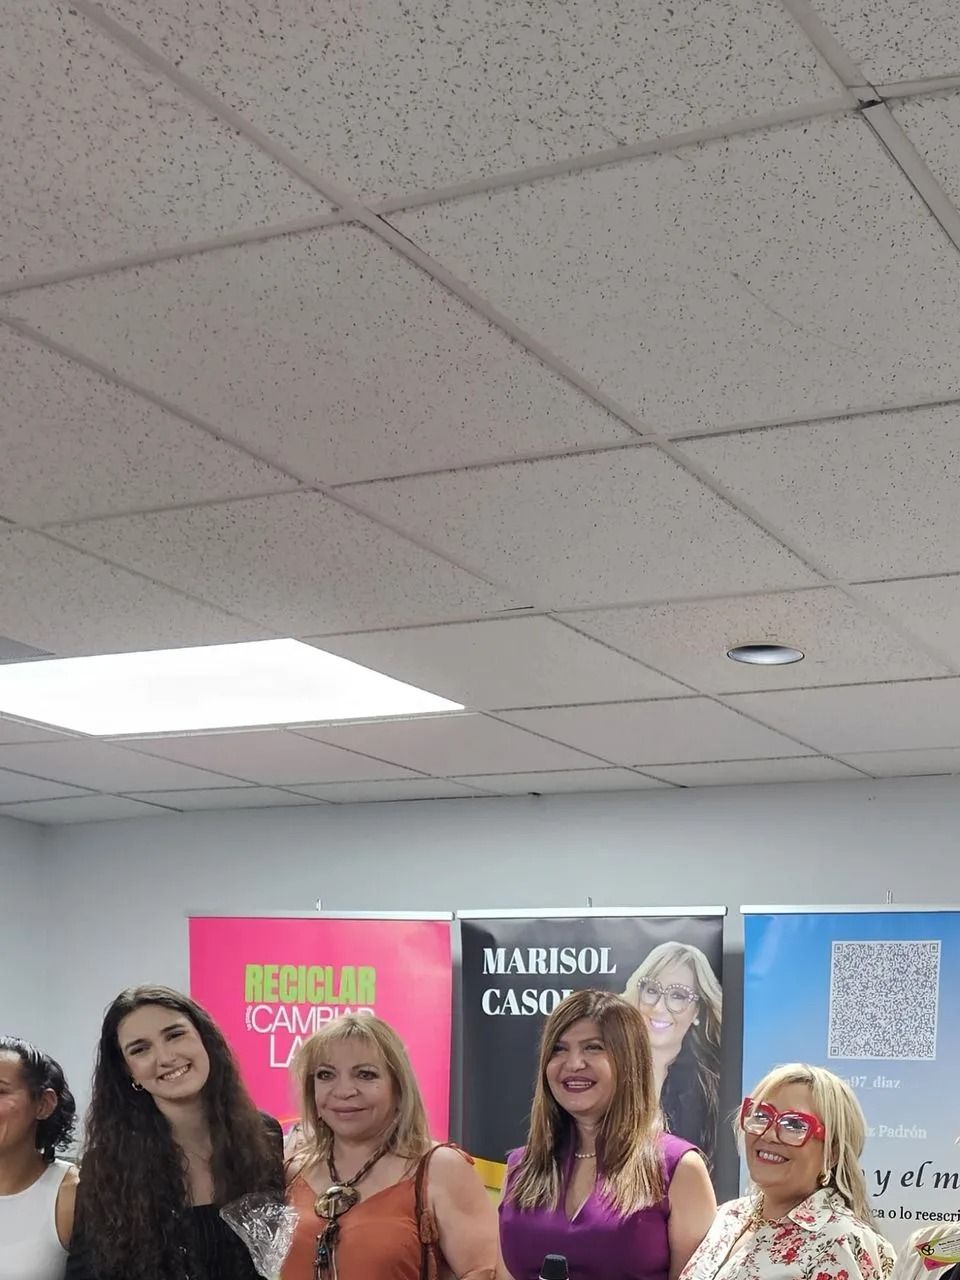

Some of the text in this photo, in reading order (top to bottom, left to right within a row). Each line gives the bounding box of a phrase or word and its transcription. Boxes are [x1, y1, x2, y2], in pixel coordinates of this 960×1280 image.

[482, 947, 617, 975] MARISOL
[244, 964, 376, 1005] RECICLAR
[879, 1124, 927, 1139] Padrón
[872, 1169, 891, 1197] y
[900, 1160, 933, 1188] el
[888, 1209, 896, 1219] o
[900, 1206, 912, 1220] lo
